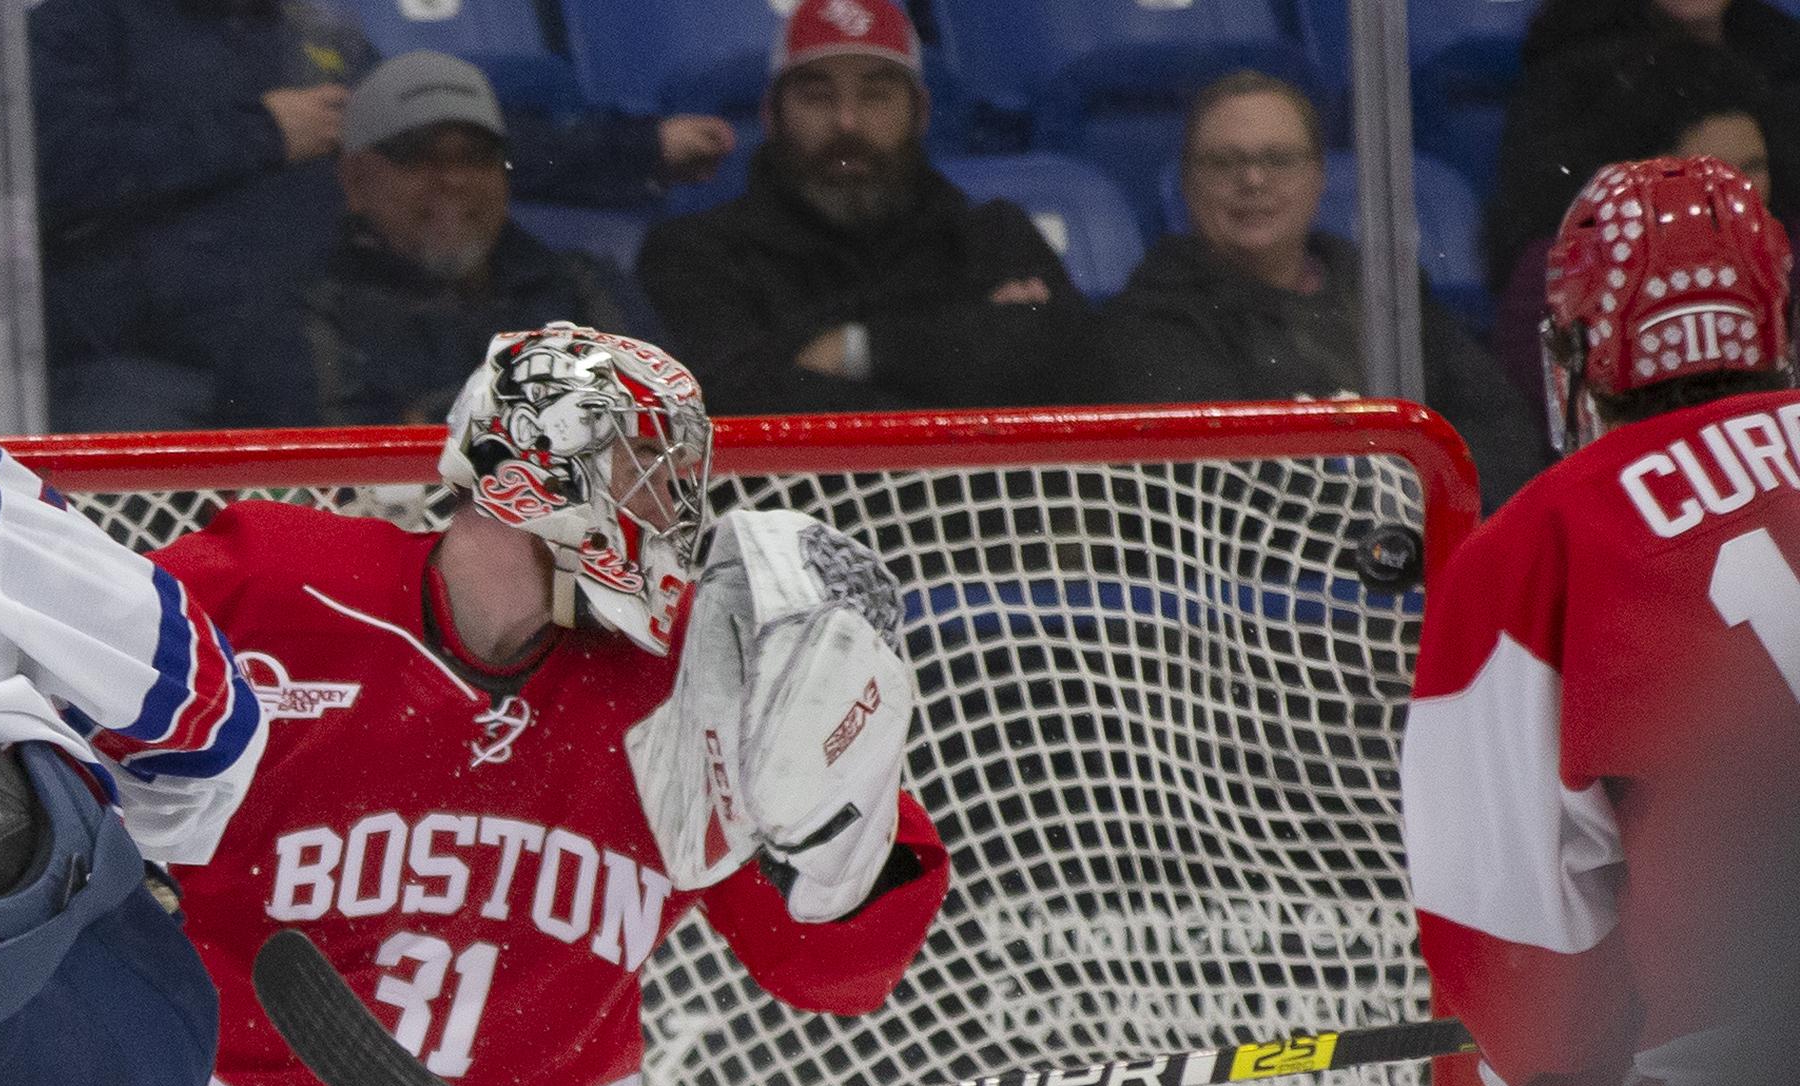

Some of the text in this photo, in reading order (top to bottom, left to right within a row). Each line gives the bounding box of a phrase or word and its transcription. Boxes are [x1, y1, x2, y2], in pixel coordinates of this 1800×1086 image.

[1620, 402, 1800, 538] CUR
[264, 811, 673, 973] BOSTON
[374, 932, 500, 1078] 31
[1252, 1033, 1317, 1073] 25
